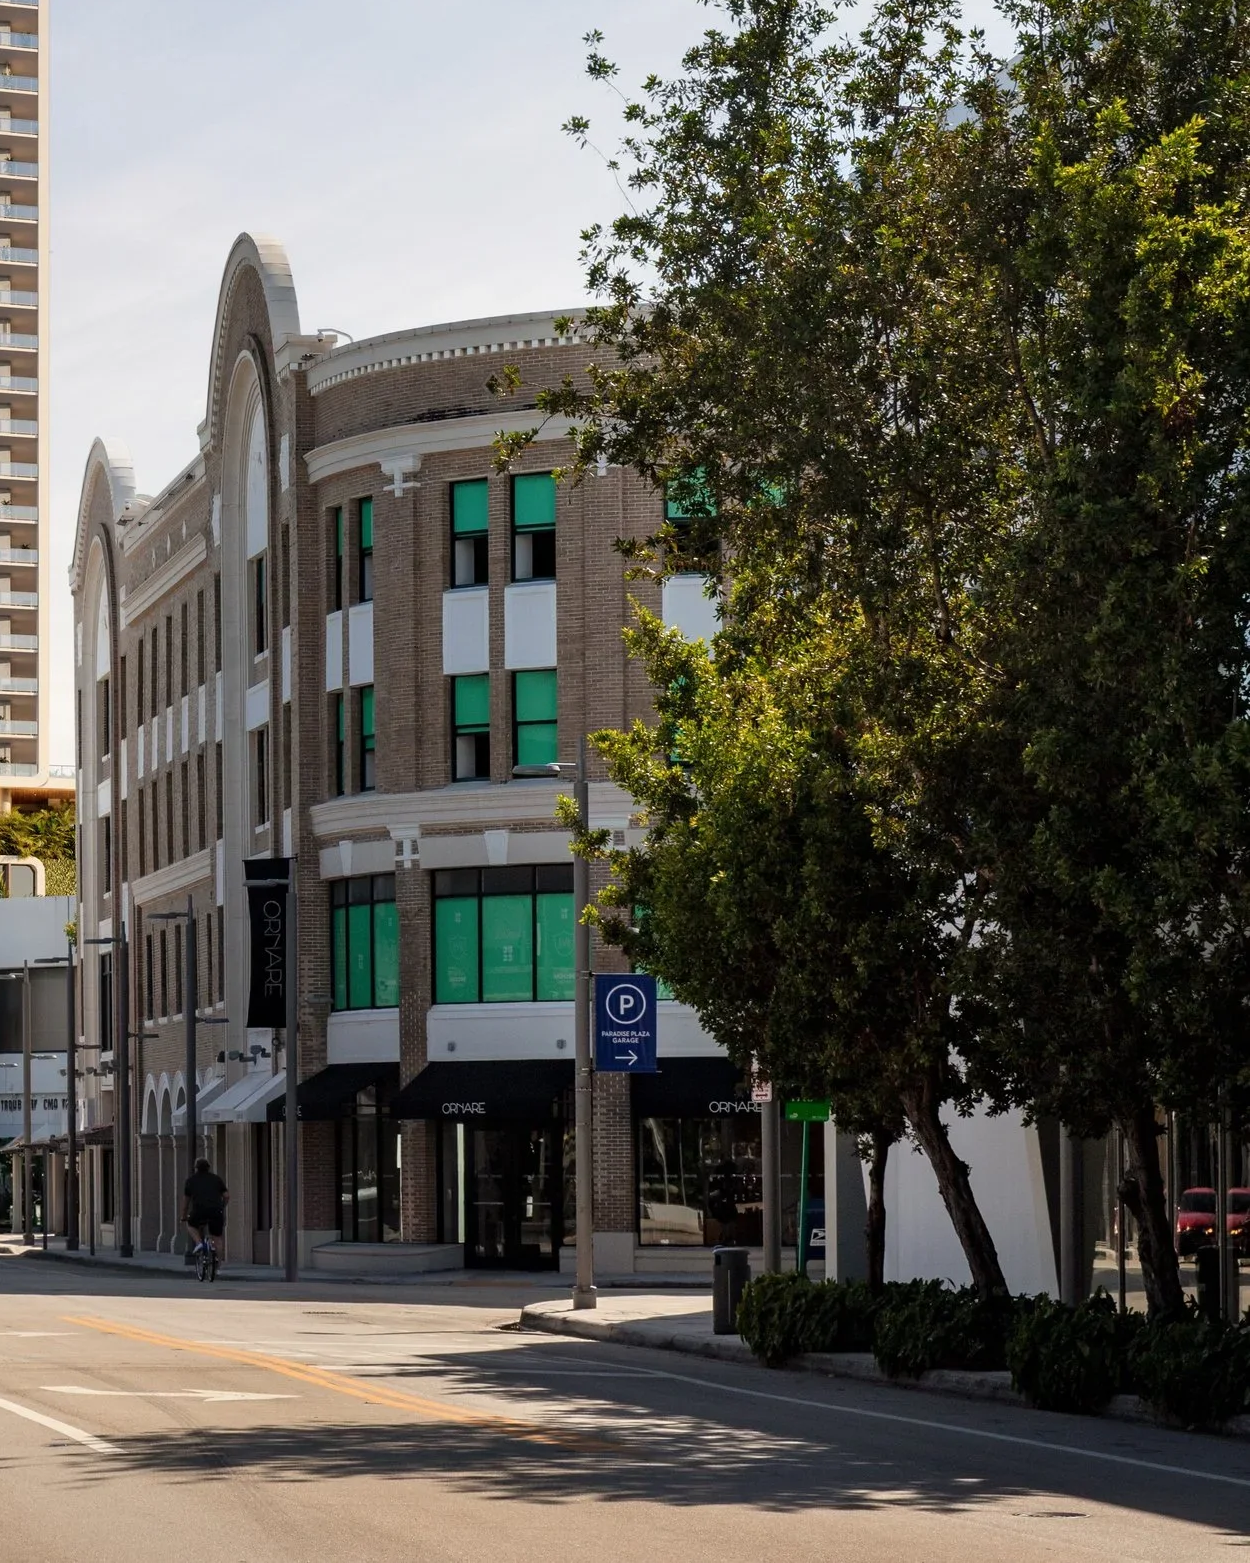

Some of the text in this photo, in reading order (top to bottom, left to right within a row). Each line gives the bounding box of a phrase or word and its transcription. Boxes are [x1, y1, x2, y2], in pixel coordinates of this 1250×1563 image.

[263, 900, 282, 998] ORNARE
[619, 994, 635, 1015] P
[441, 1102, 486, 1114] ORNARE
